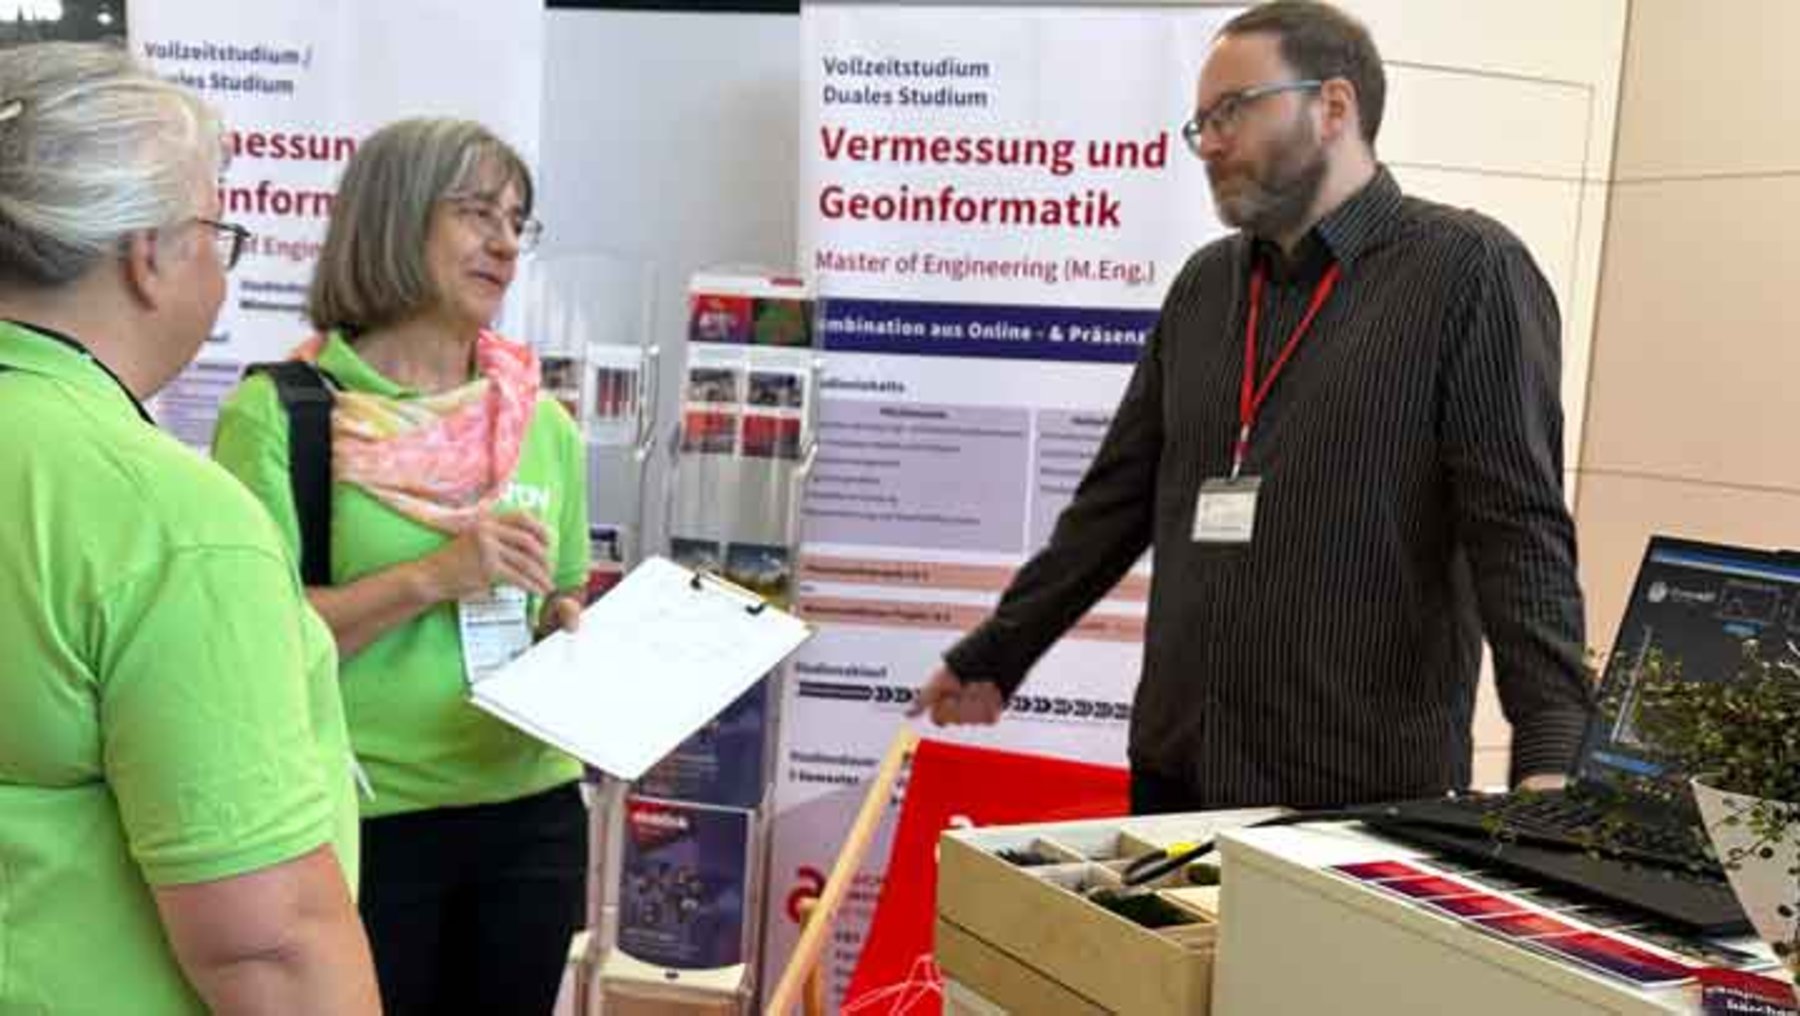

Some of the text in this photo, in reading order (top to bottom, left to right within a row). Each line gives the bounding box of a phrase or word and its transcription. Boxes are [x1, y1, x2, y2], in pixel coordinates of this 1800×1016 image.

[822, 56, 990, 79] Vollzeitstudium
[209, 72, 294, 95] Studium
[823, 84, 988, 108] Duales Studium
[819, 125, 1169, 176] Vermessung und
[818, 184, 1122, 229] Geoinformatik
[815, 249, 1156, 284] Master of Engineering (M.Eng.)
[930, 322, 965, 339] aus
[967, 320, 1032, 342] Online
